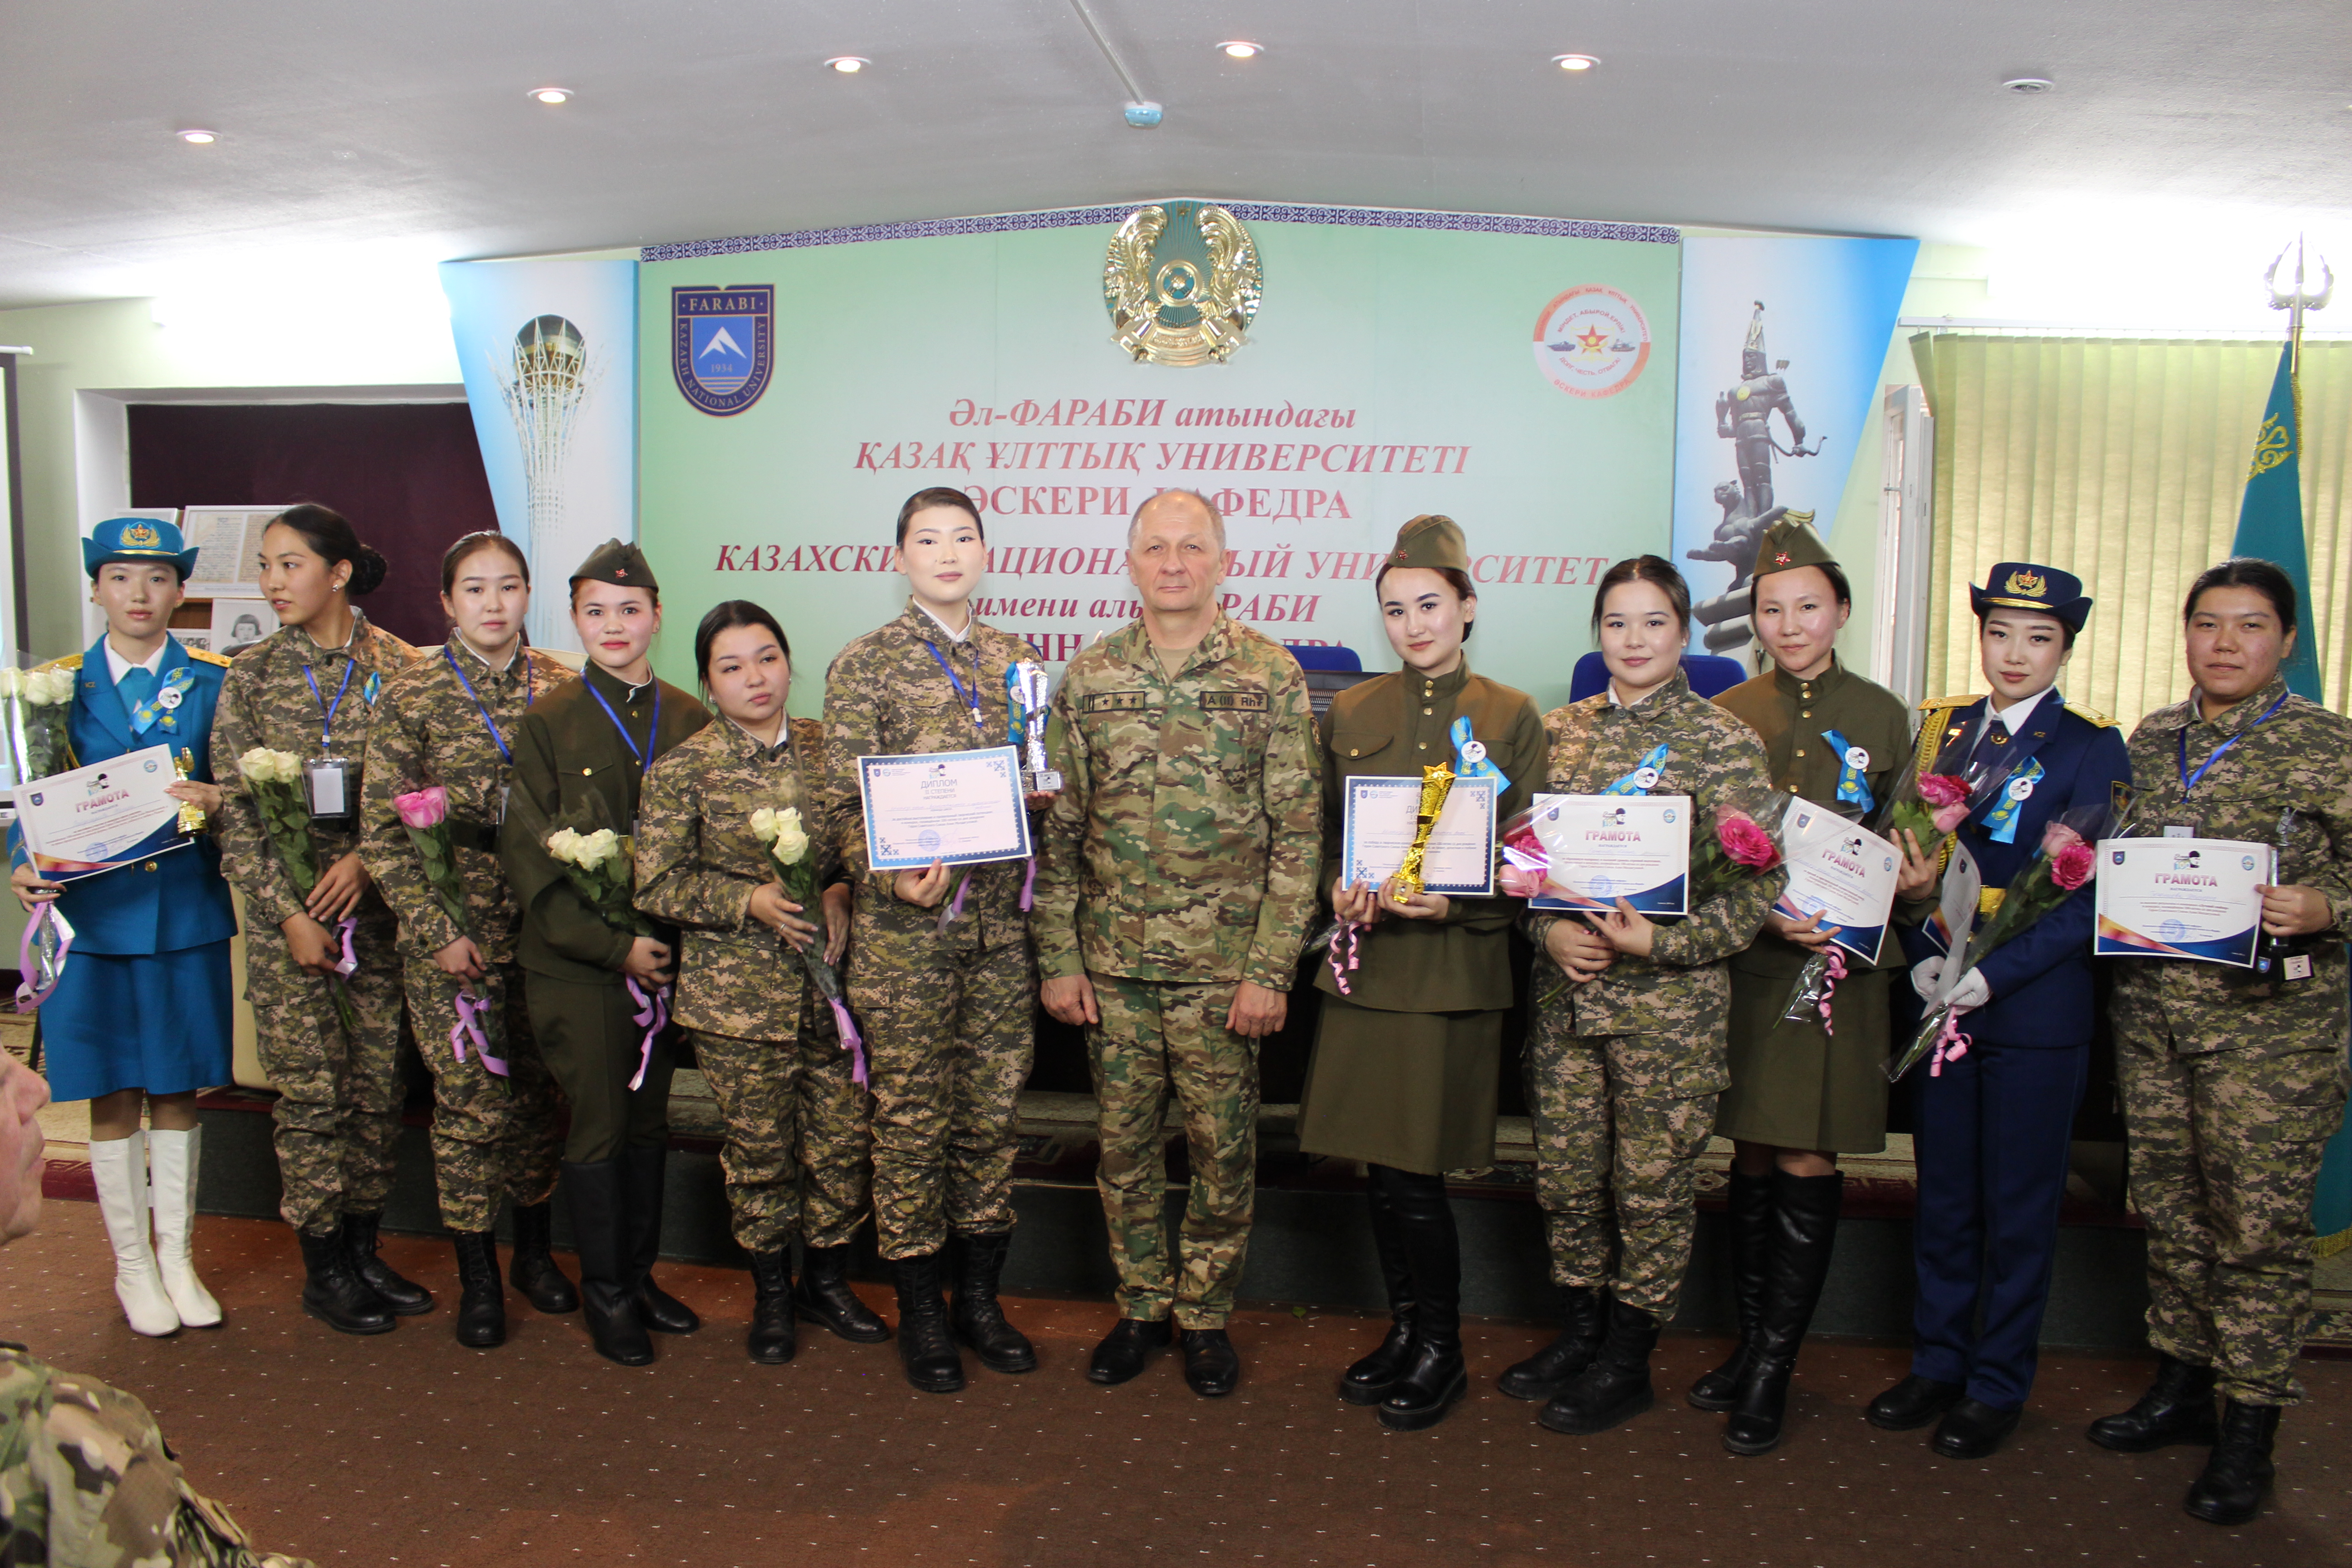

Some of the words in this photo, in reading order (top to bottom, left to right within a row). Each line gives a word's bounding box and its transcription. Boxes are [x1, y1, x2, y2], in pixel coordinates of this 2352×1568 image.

[689, 297, 756, 311] FARABI
[680, 323, 690, 376] KAZAKH
[686, 379, 741, 407] NATIONAL
[742, 322, 766, 397] UNIVERSITY
[710, 363, 733, 373] 1934
[1591, 379, 1631, 397] КАФЕДРА
[950, 398, 1167, 426] Әл-ФАРАБИ
[853, 442, 975, 475] ҚАЗАҚ
[986, 442, 1146, 476] ҰЛТТЫҚ
[1156, 442, 1472, 474] УНИВЕРСИТЕТІ
[1153, 487, 1352, 525] ФЕДРА
[714, 544, 900, 573] КАЗАХСКИ
[1306, 551, 1609, 585] УНИСИТЕТ
[976, 597, 1078, 617] имени
[1207, 695, 1216, 705] A
[921, 779, 957, 789] ДИПЛОМ
[75, 789, 129, 813] ГРАМОТА
[1586, 830, 1641, 842] ГРАМОТА
[1822, 848, 1865, 878] ГРАМОТА
[2155, 873, 2218, 887] ГРАМОТА
